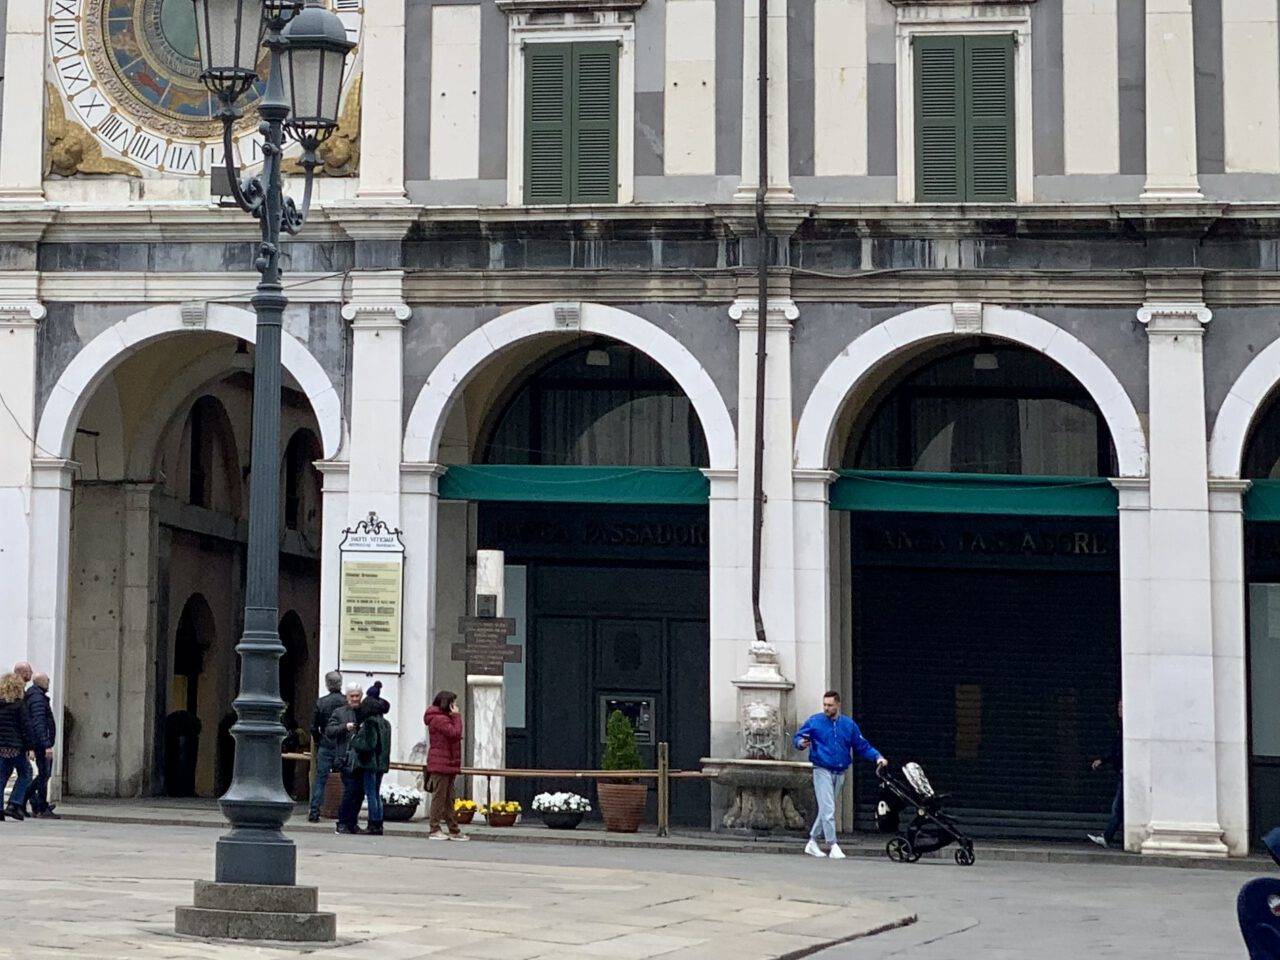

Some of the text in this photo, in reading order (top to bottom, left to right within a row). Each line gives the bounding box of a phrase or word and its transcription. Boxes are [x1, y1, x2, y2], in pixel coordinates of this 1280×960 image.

[54, 24, 78, 53] XII
[61, 62, 89, 89] XI
[79, 94, 105, 118] X
[170, 147, 196, 171] VII
